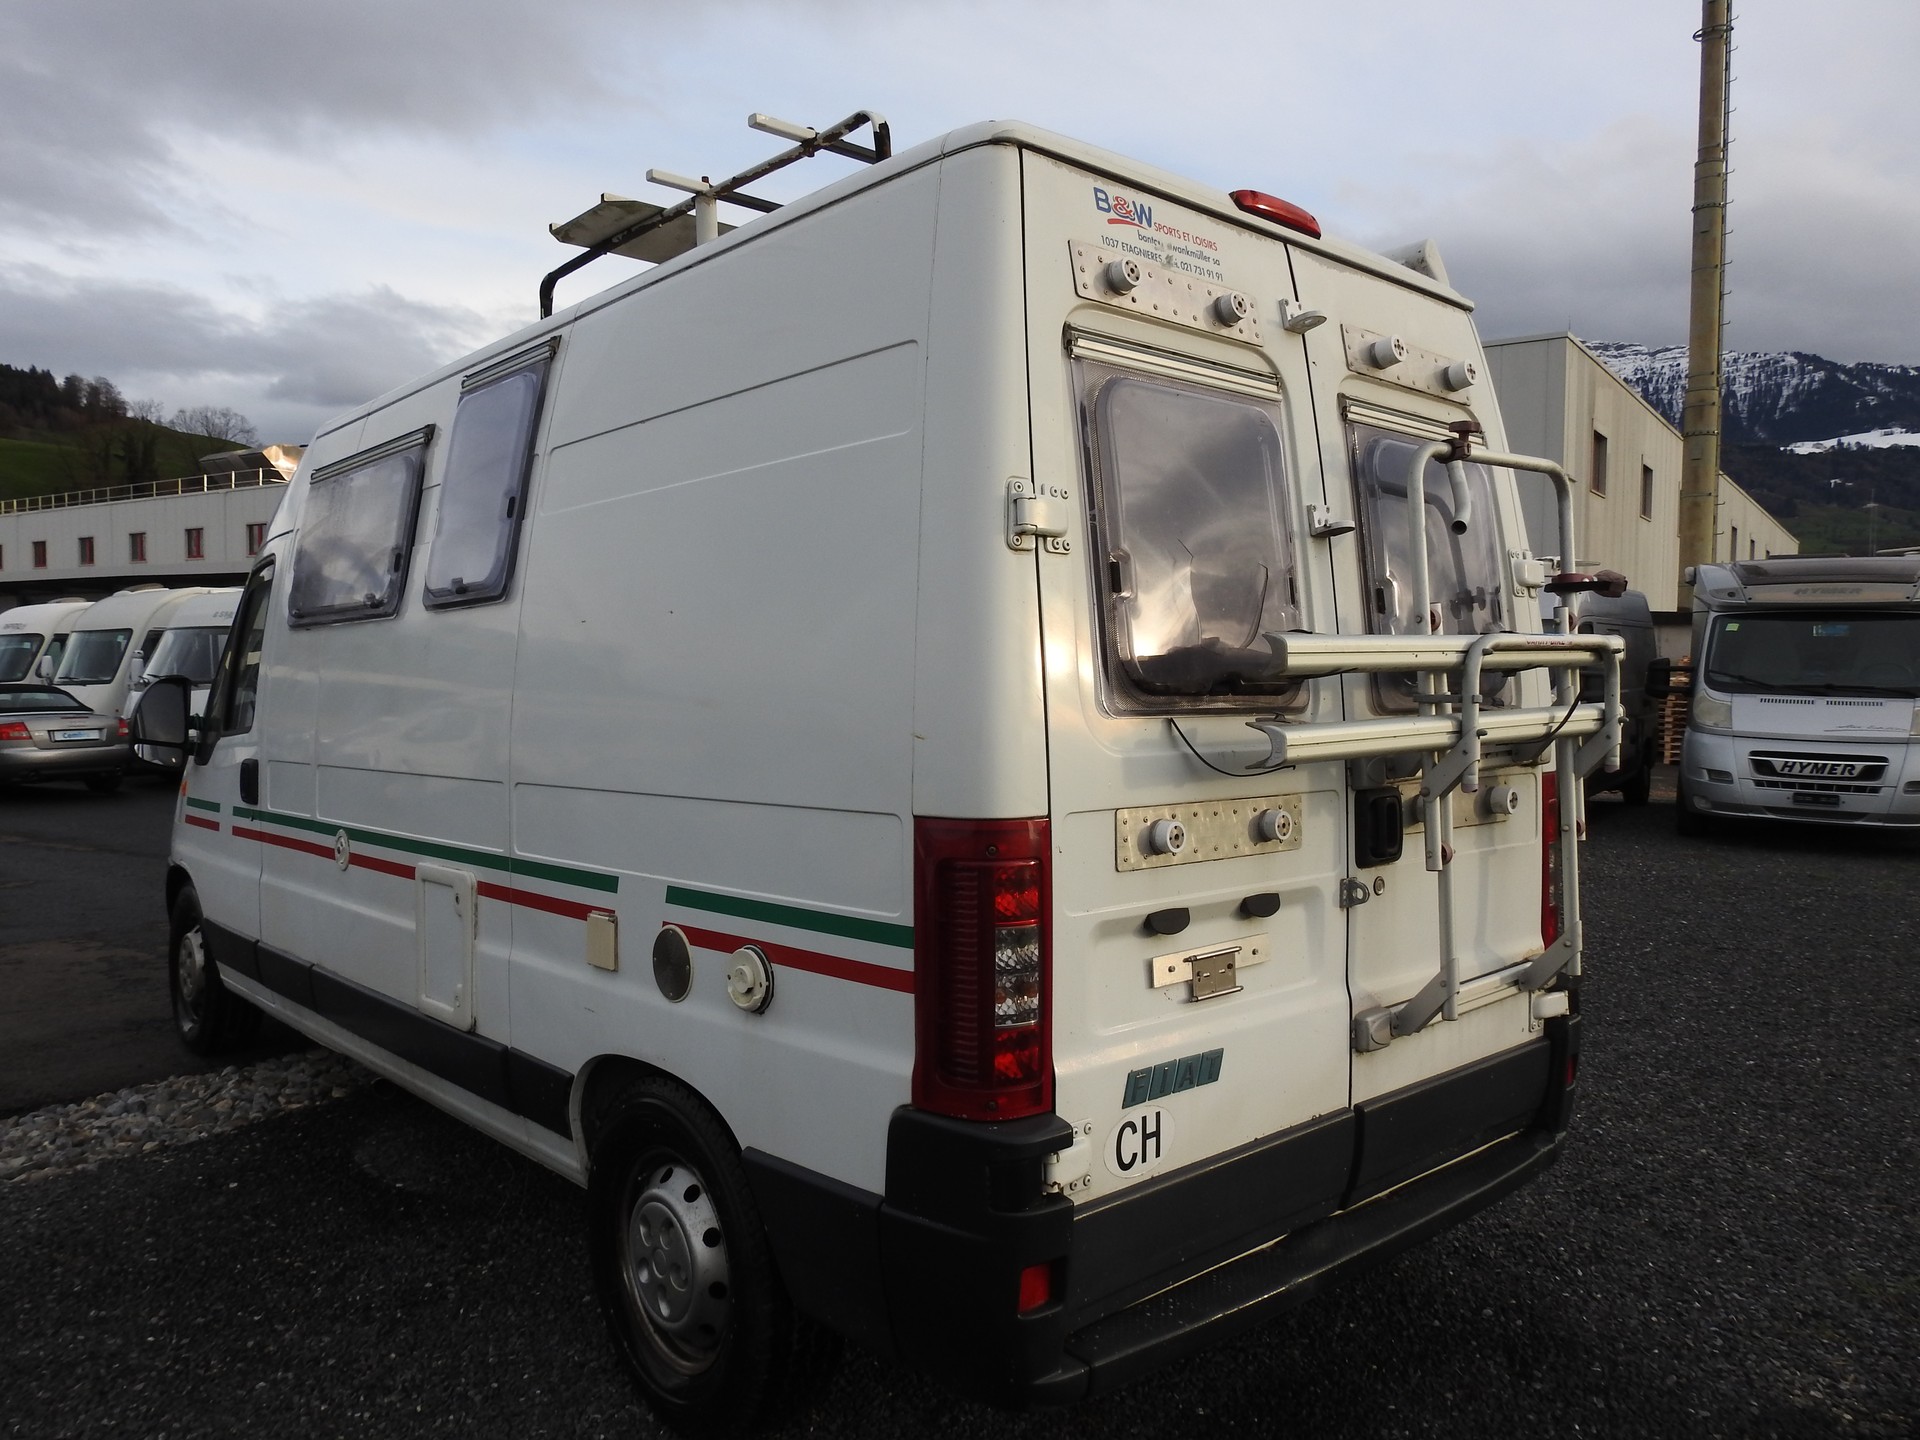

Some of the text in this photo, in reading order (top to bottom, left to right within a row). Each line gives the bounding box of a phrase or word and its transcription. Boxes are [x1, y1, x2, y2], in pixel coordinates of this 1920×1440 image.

[1093, 186, 1218, 251] B&W SPORTS ET LOISIRS
[1101, 235, 1119, 249] 1037
[1180, 261, 1193, 274] 021
[1194, 265, 1206, 277] 731
[1206, 269, 1215, 279] 91
[1215, 273, 1223, 282] 91
[1212, 257, 1220, 266] sa
[1780, 760, 1855, 776] HYMER
[1128, 1051, 1221, 1105] FIAT
[1115, 1111, 1161, 1171] CH
